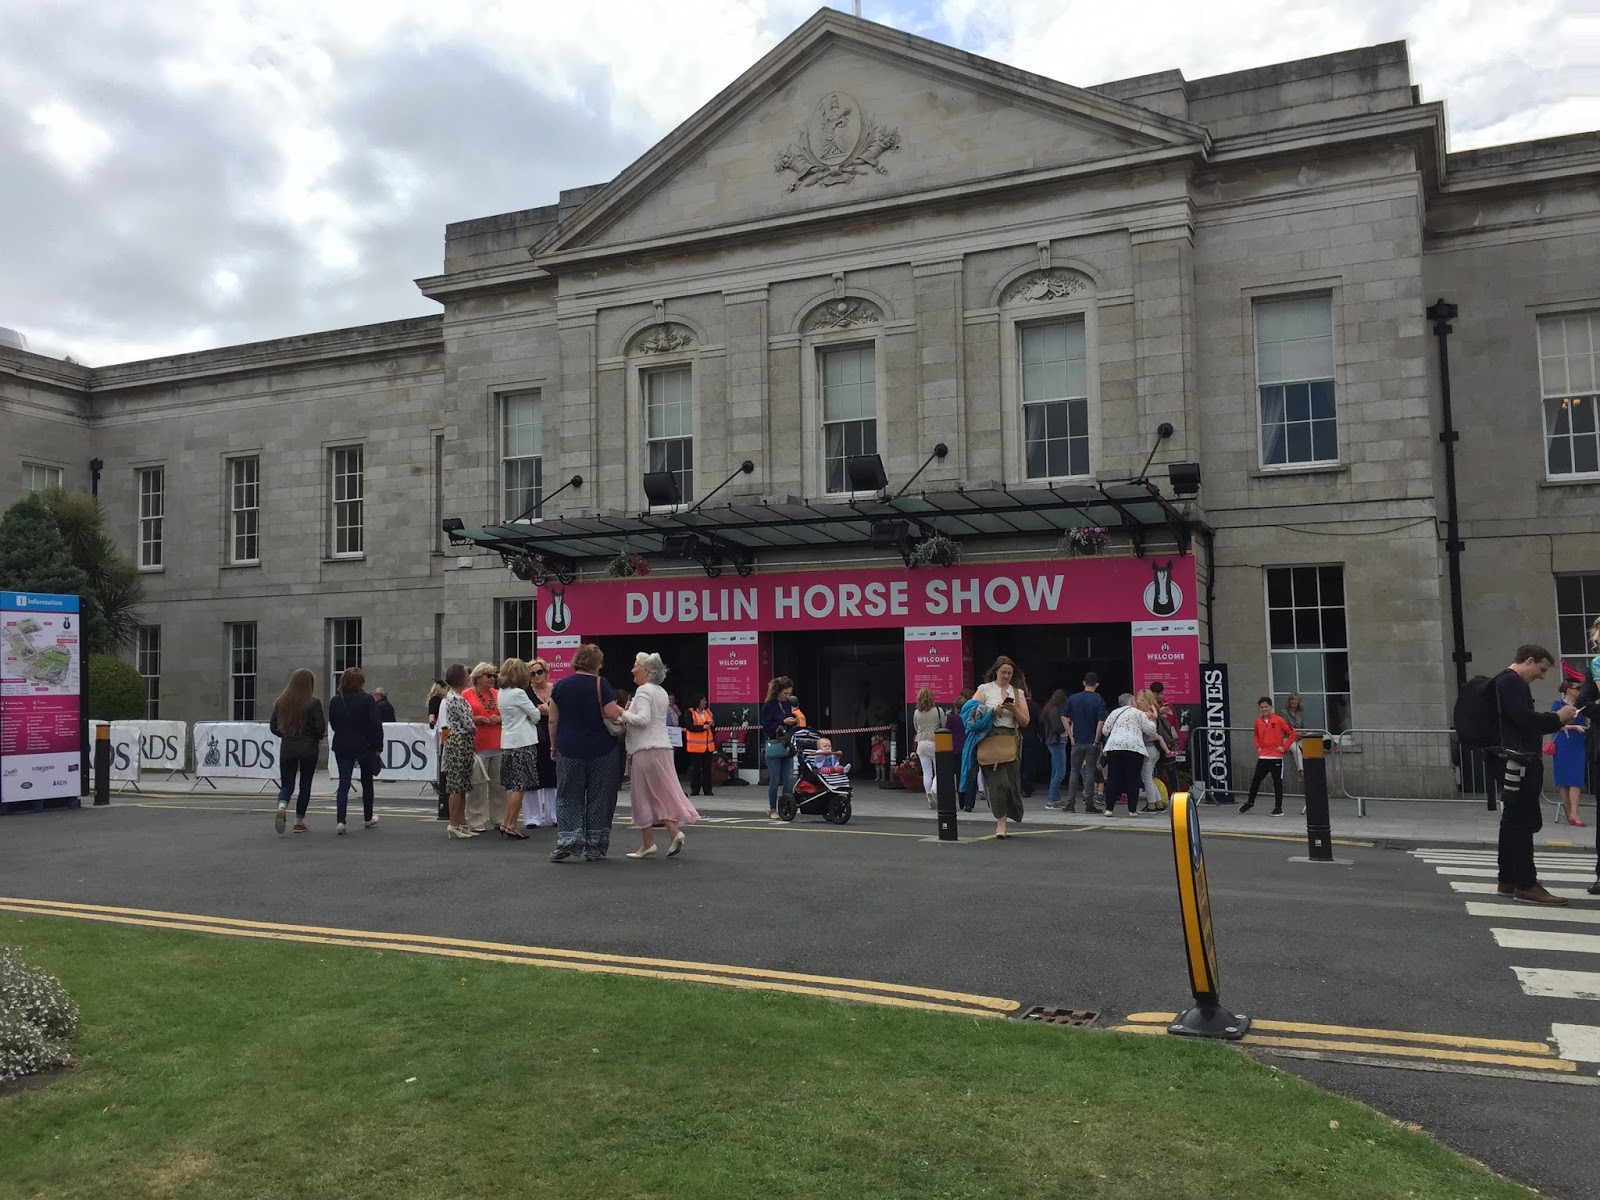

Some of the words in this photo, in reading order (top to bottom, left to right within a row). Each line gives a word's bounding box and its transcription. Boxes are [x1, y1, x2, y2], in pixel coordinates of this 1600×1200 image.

[27, 598, 63, 607] Information
[625, 587, 759, 624] DUBLIN
[775, 581, 909, 619] HORSE
[925, 574, 1065, 614] SHOW
[1204, 669, 1229, 796] LONGINES
[224, 738, 275, 769] RDS
[380, 739, 428, 770] DS
